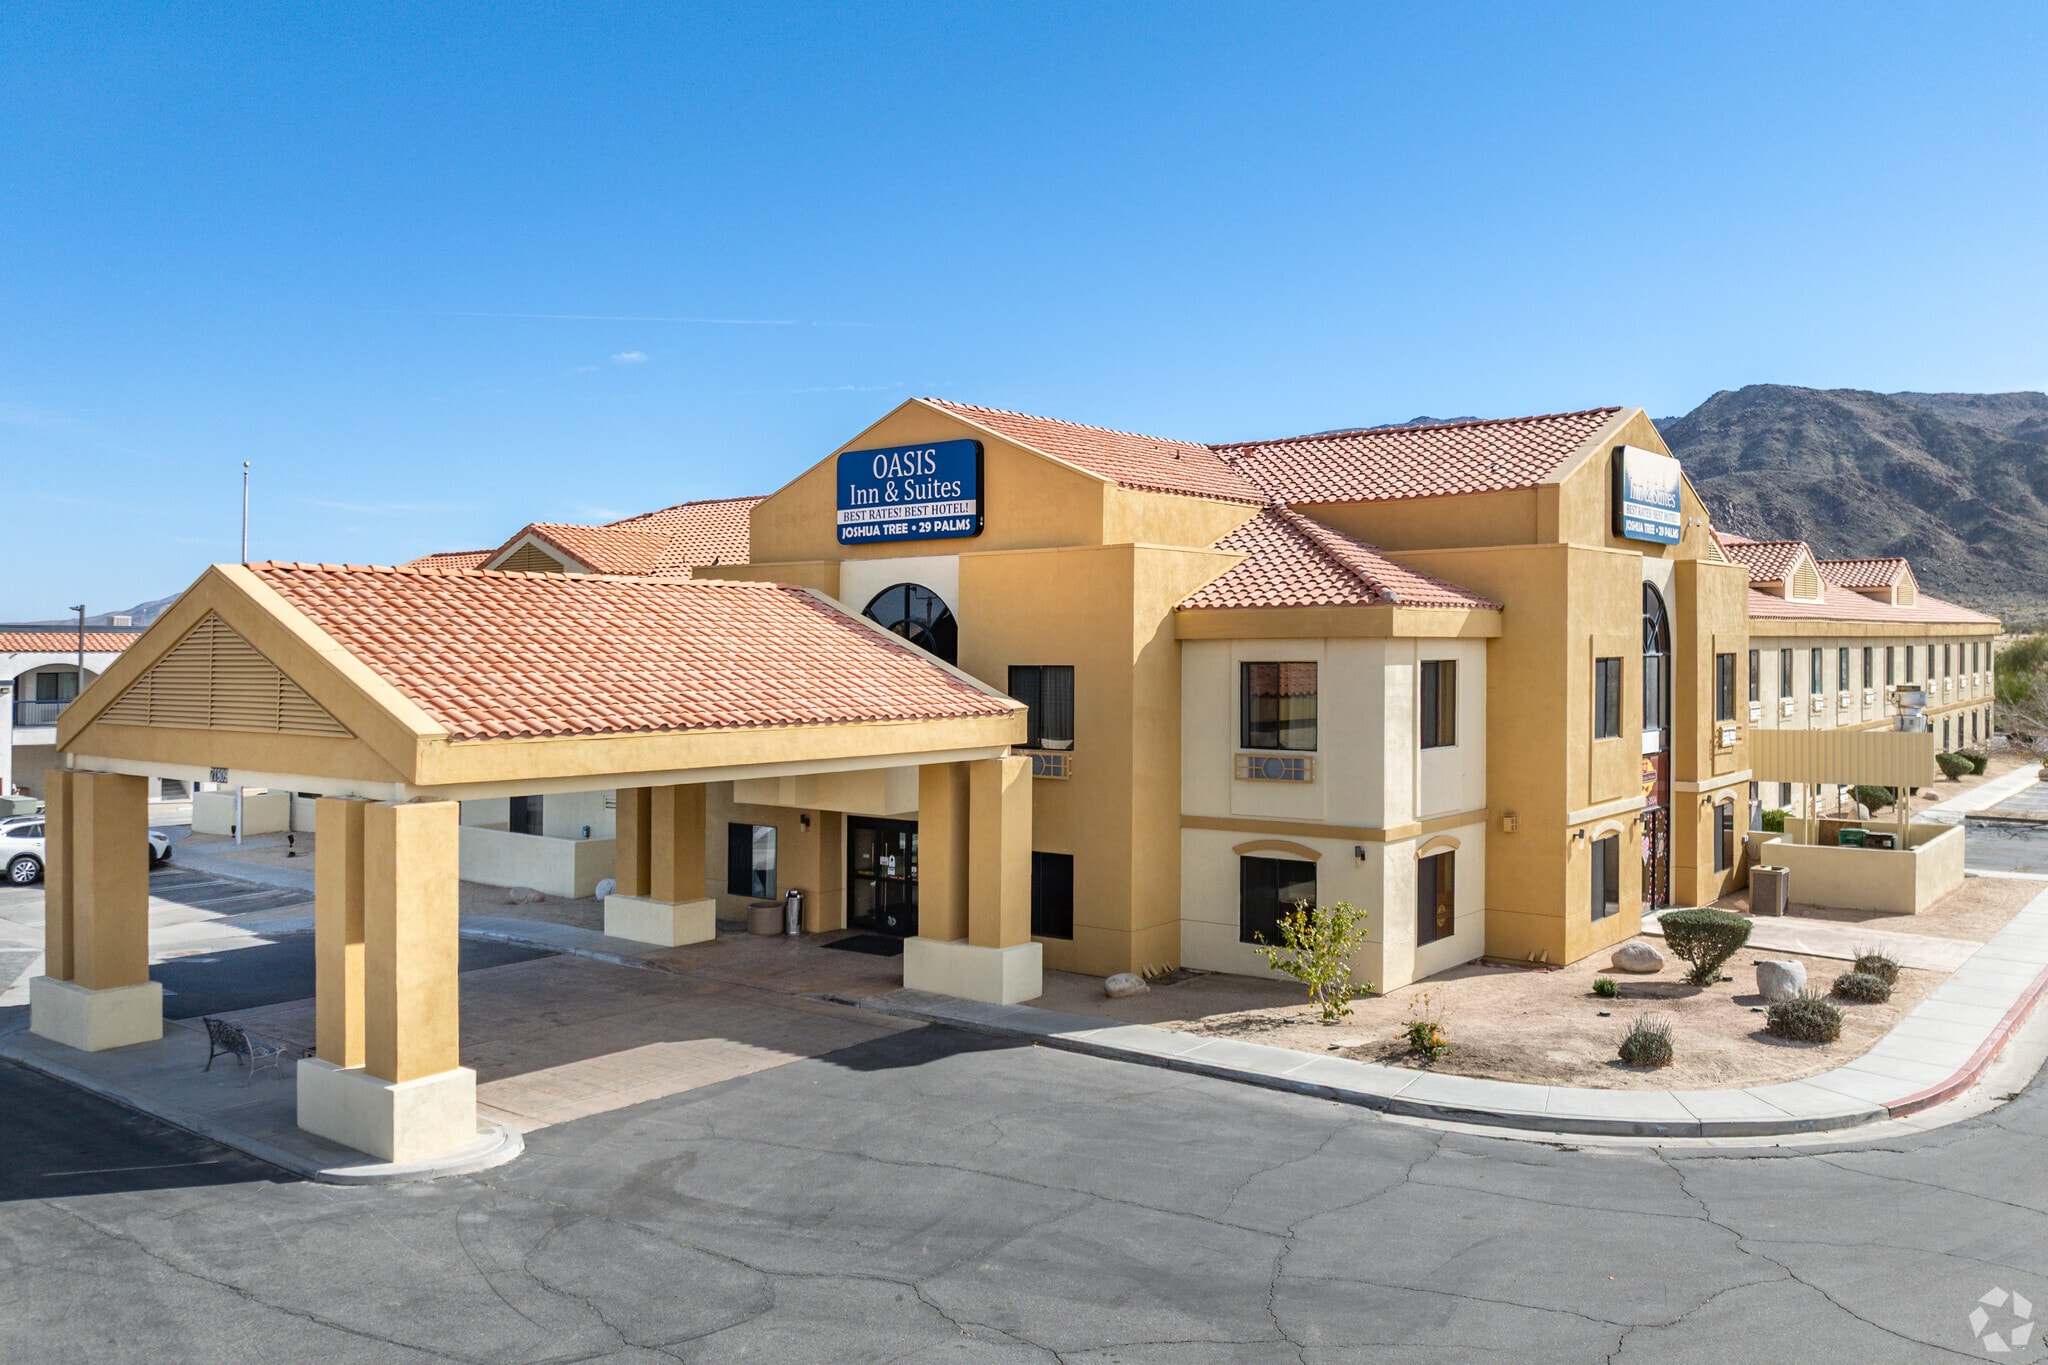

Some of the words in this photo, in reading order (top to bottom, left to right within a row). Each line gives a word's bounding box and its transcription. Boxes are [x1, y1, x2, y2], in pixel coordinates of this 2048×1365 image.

[873, 449, 936, 479] OASIS
[850, 484, 879, 505] Inn
[884, 480, 899, 502] &
[904, 478, 961, 501] Suites
[843, 511, 867, 522] BEST
[869, 507, 902, 520] RATES!
[904, 505, 929, 517] BEST
[931, 502, 969, 515] HOTEL!
[1626, 503, 1637, 515] BEST
[842, 525, 881, 540] JOSHUA
[883, 523, 908, 535] TREE
[919, 521, 931, 533] 29
[934, 518, 971, 532] PALMS
[1626, 520, 1643, 532] JOSHUA
[1644, 522, 1655, 534] TREE
[1665, 527, 1678, 538] PALMS
